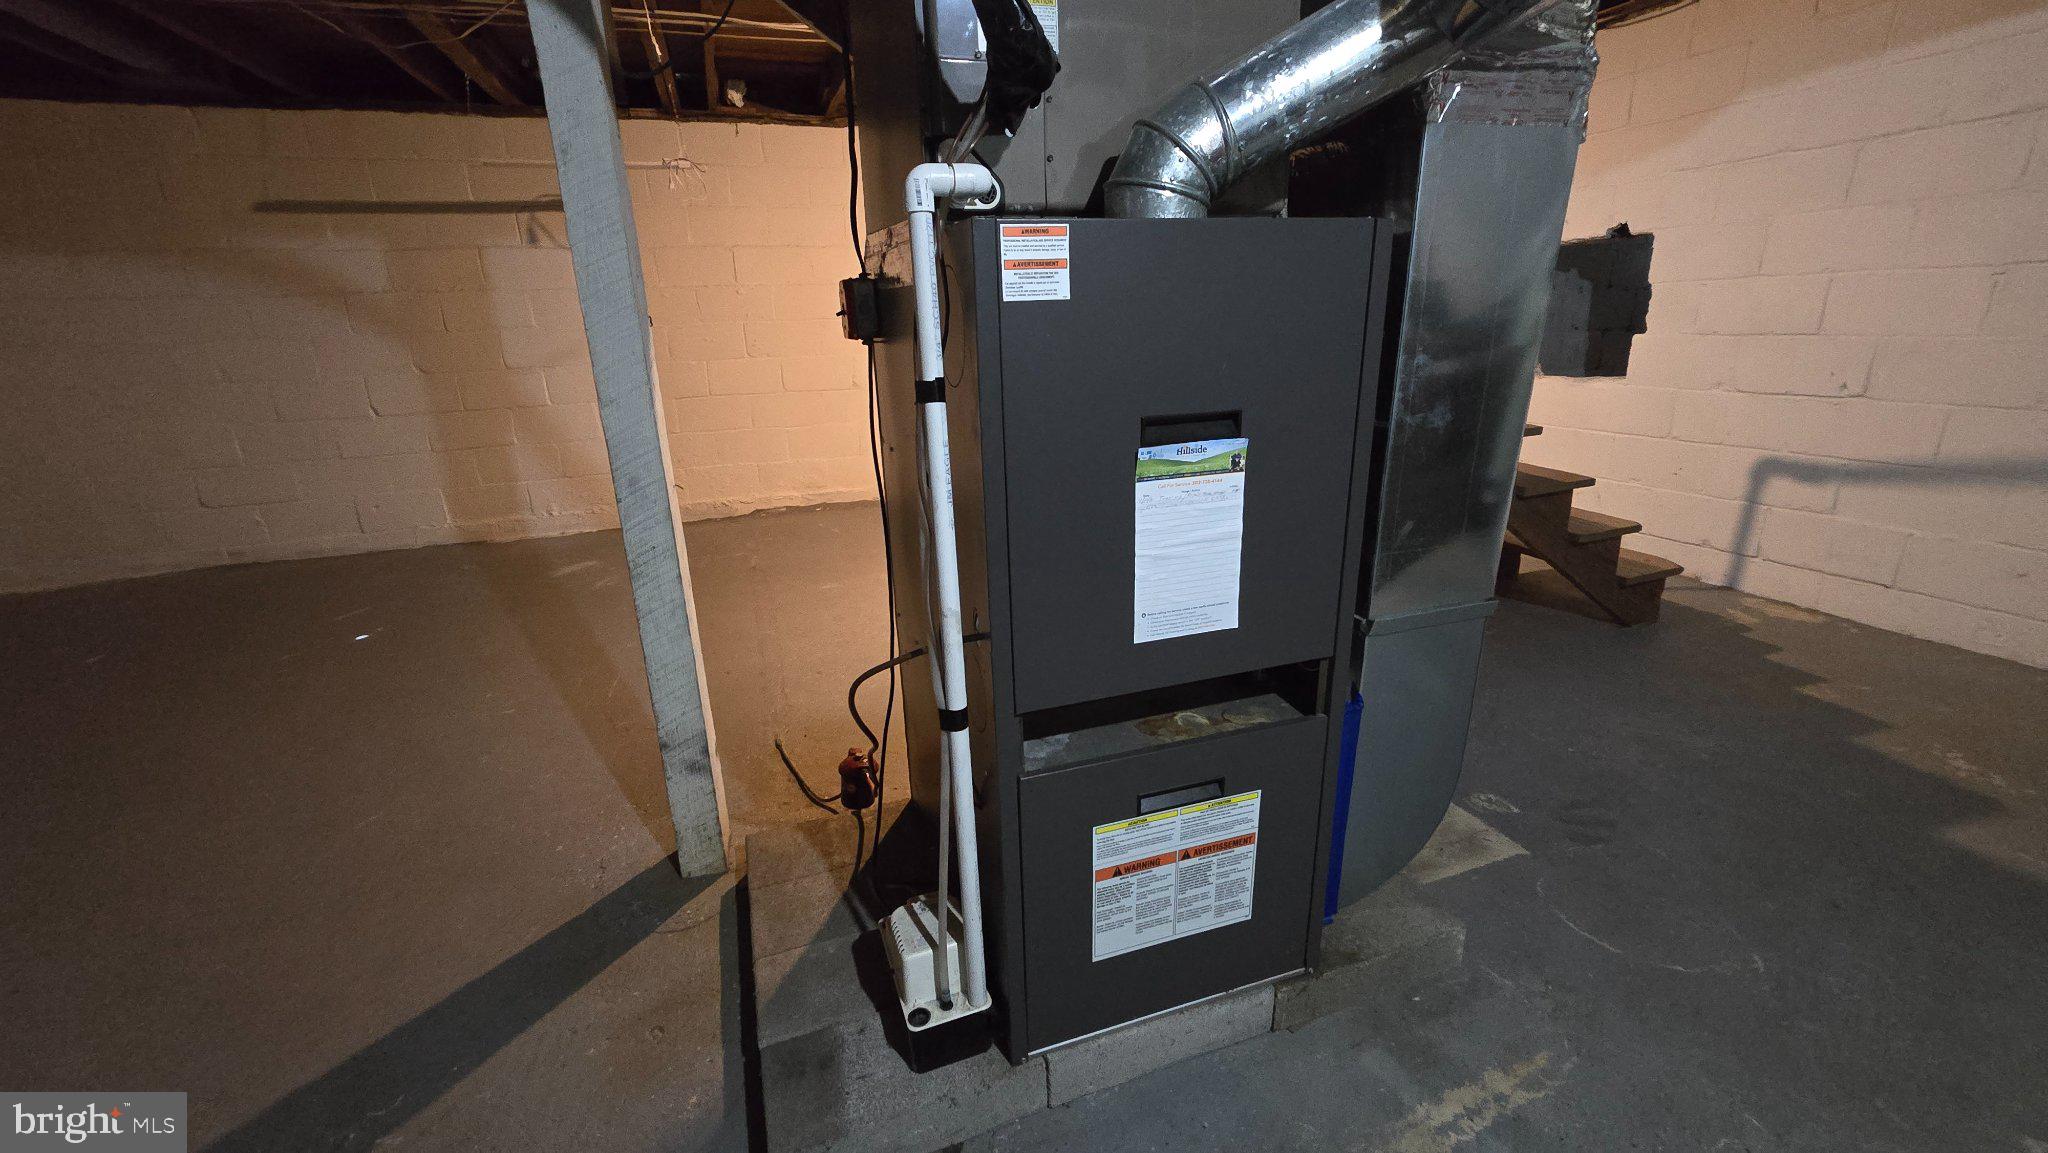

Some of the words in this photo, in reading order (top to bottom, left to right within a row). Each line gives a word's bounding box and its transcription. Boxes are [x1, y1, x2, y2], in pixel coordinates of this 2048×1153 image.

[1176, 445, 1208, 456] Hillside
[1193, 835, 1254, 857] AVERTISSEMENT
[1124, 857, 1161, 874] WARNING
